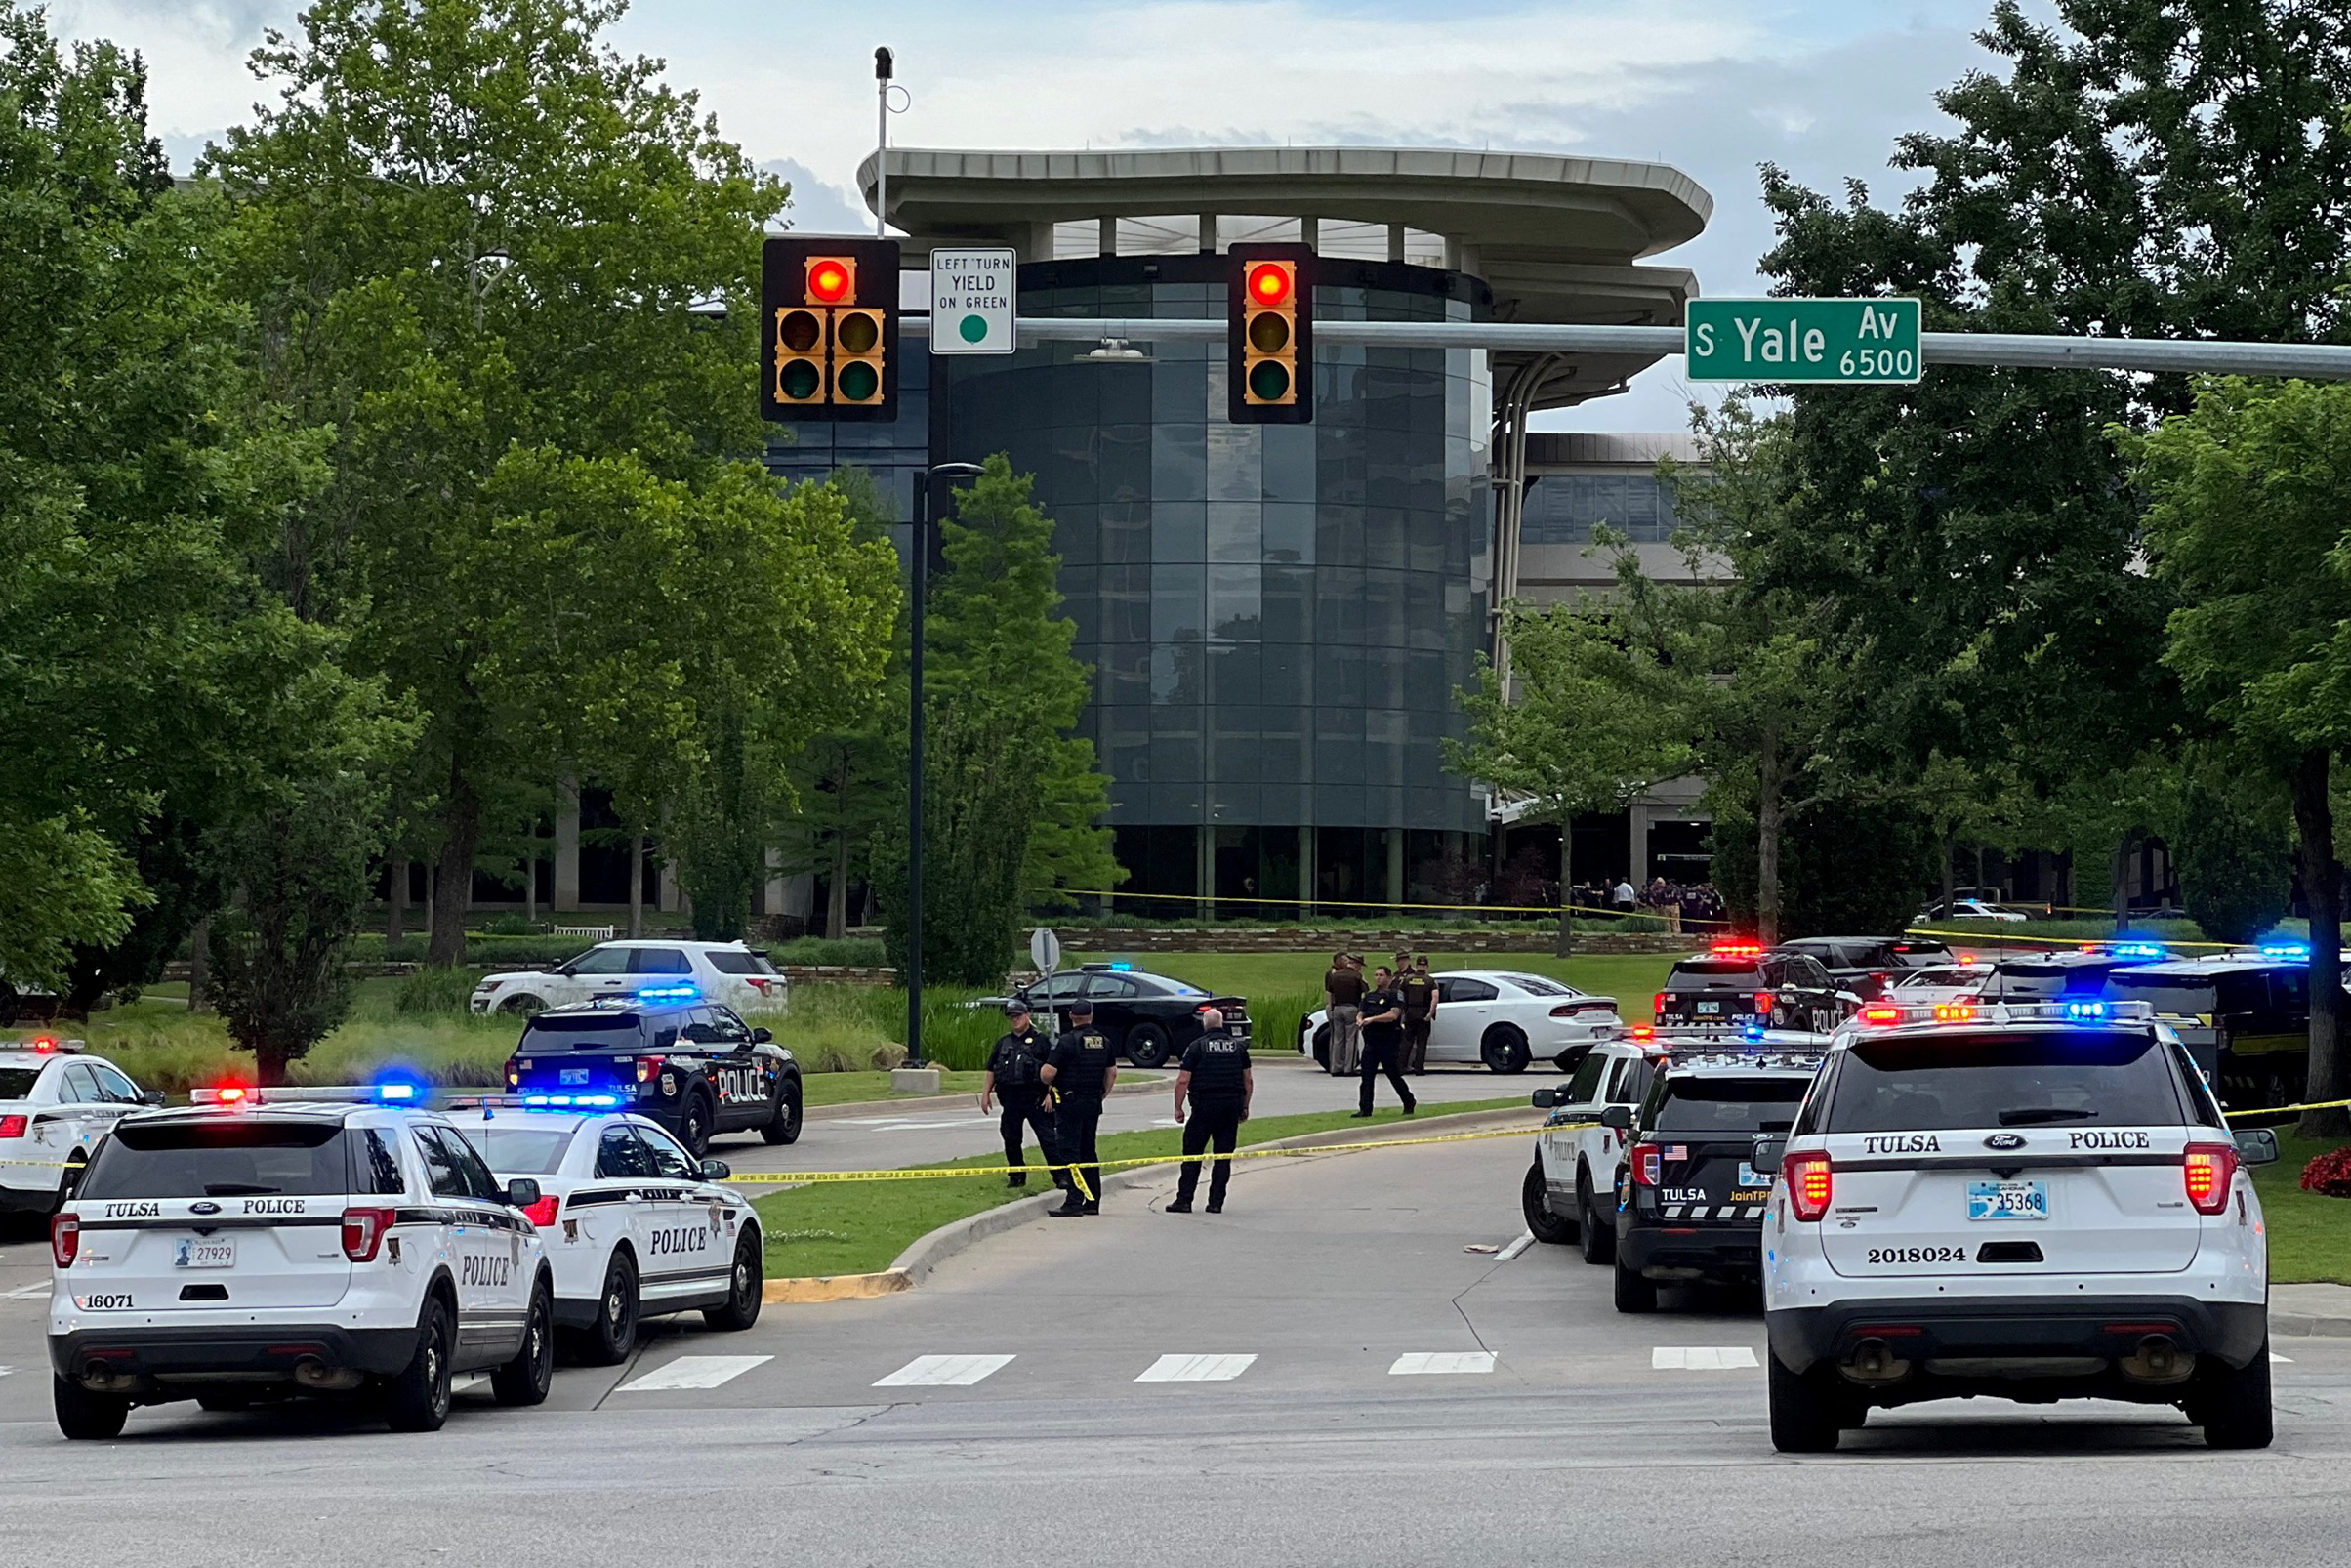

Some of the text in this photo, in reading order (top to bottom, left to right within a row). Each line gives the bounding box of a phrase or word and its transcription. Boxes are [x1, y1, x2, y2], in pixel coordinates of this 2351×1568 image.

[937, 258, 1010, 270] LEFT TURN
[951, 275, 995, 291] YIELD
[939, 297, 1007, 309] ON GREEN
[1695, 305, 1898, 363] S Yale Av
[1839, 349, 1913, 376] 6500
[1208, 1041, 1235, 1052] POLICE
[717, 1069, 768, 1105] POLICE
[1864, 1135, 1942, 1154] TULSA
[1992, 1134, 2018, 1147] Ford
[2068, 1132, 2150, 1150] POLICE
[1553, 1141, 1577, 1162] POLICE
[1662, 1188, 1707, 1201] TULSA
[1997, 1193, 2042, 1210] 35368
[105, 1202, 160, 1217] TULSA
[243, 1199, 306, 1214] POLICE
[649, 1226, 707, 1256] POLICE
[197, 1247, 232, 1260] 27929
[1868, 1247, 1966, 1263] 2018024
[462, 1255, 509, 1286] POLICE
[86, 1294, 134, 1308] 16071
